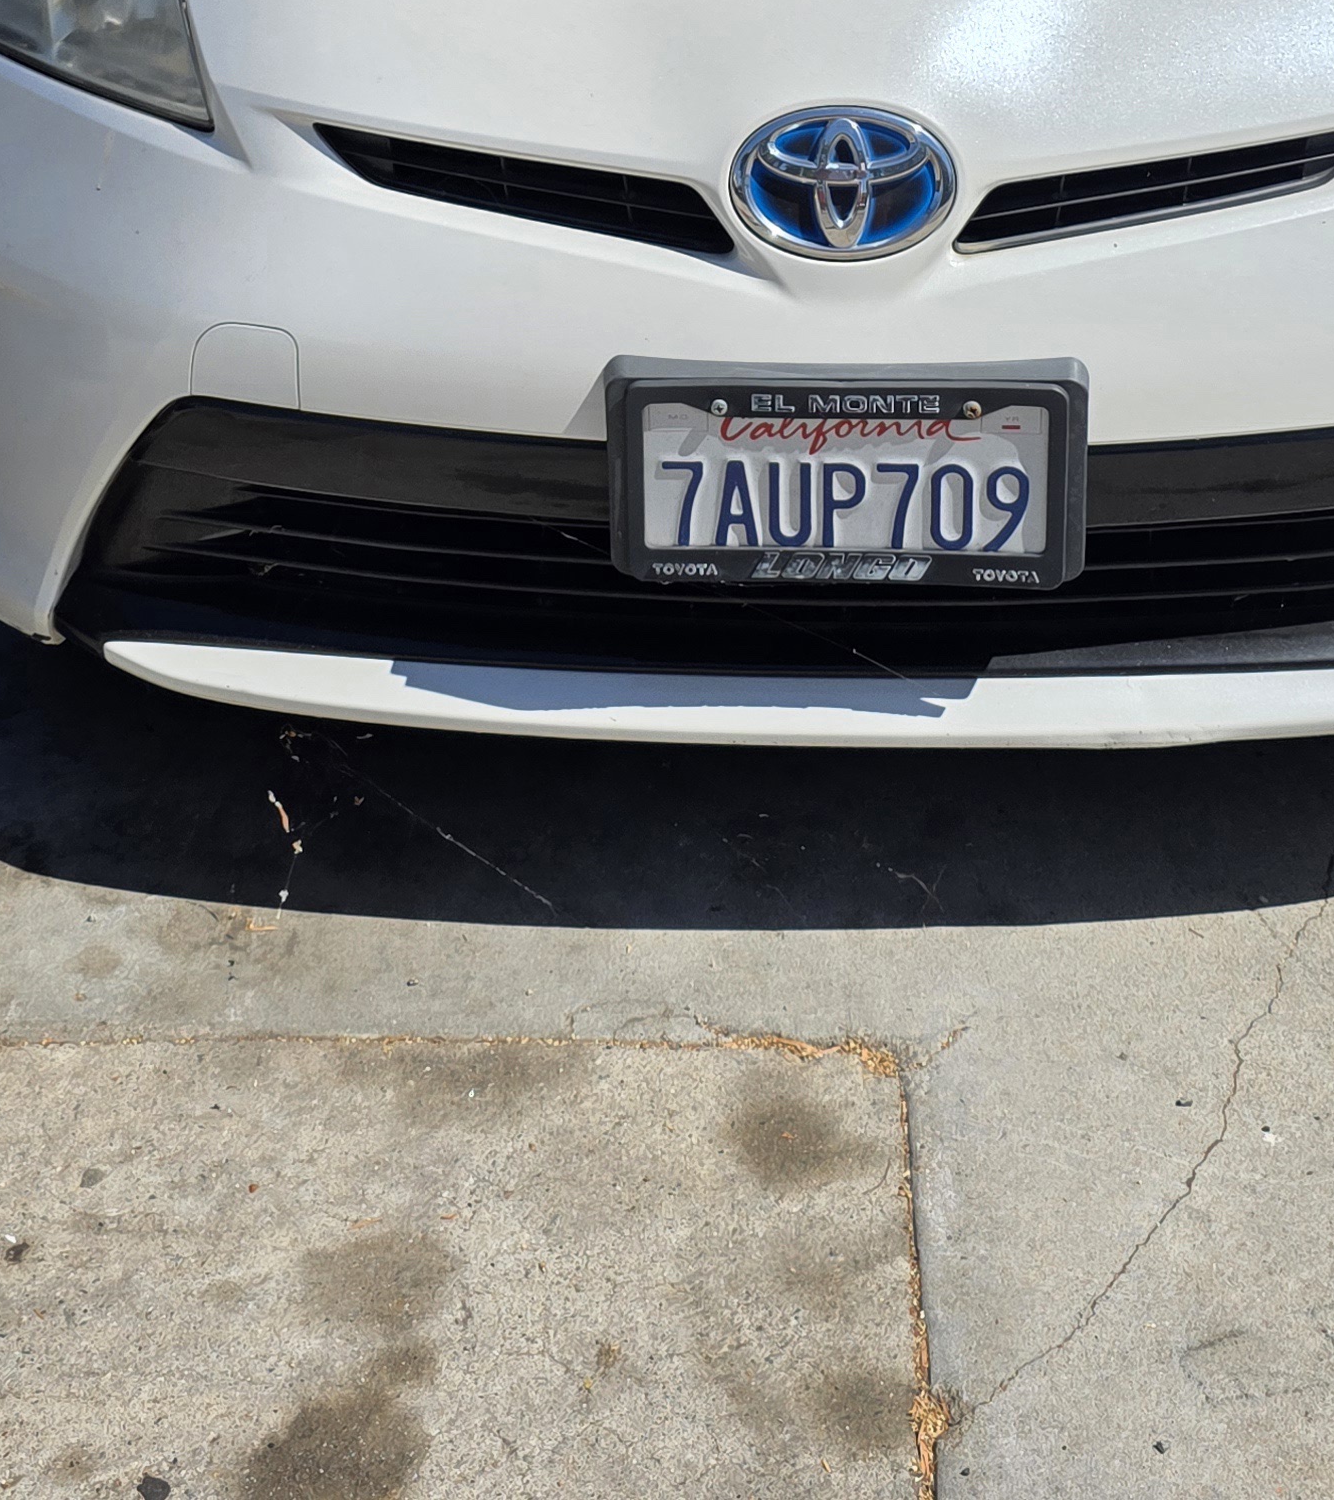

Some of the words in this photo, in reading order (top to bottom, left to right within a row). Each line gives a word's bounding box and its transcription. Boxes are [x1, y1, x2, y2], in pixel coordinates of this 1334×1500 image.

[750, 393, 796, 413] EL
[808, 394, 941, 414] MONTE
[720, 416, 982, 456] California
[661, 459, 1030, 553] 7AUP709
[652, 562, 718, 577] TOYOTA
[972, 567, 1040, 584] TOYOTA
